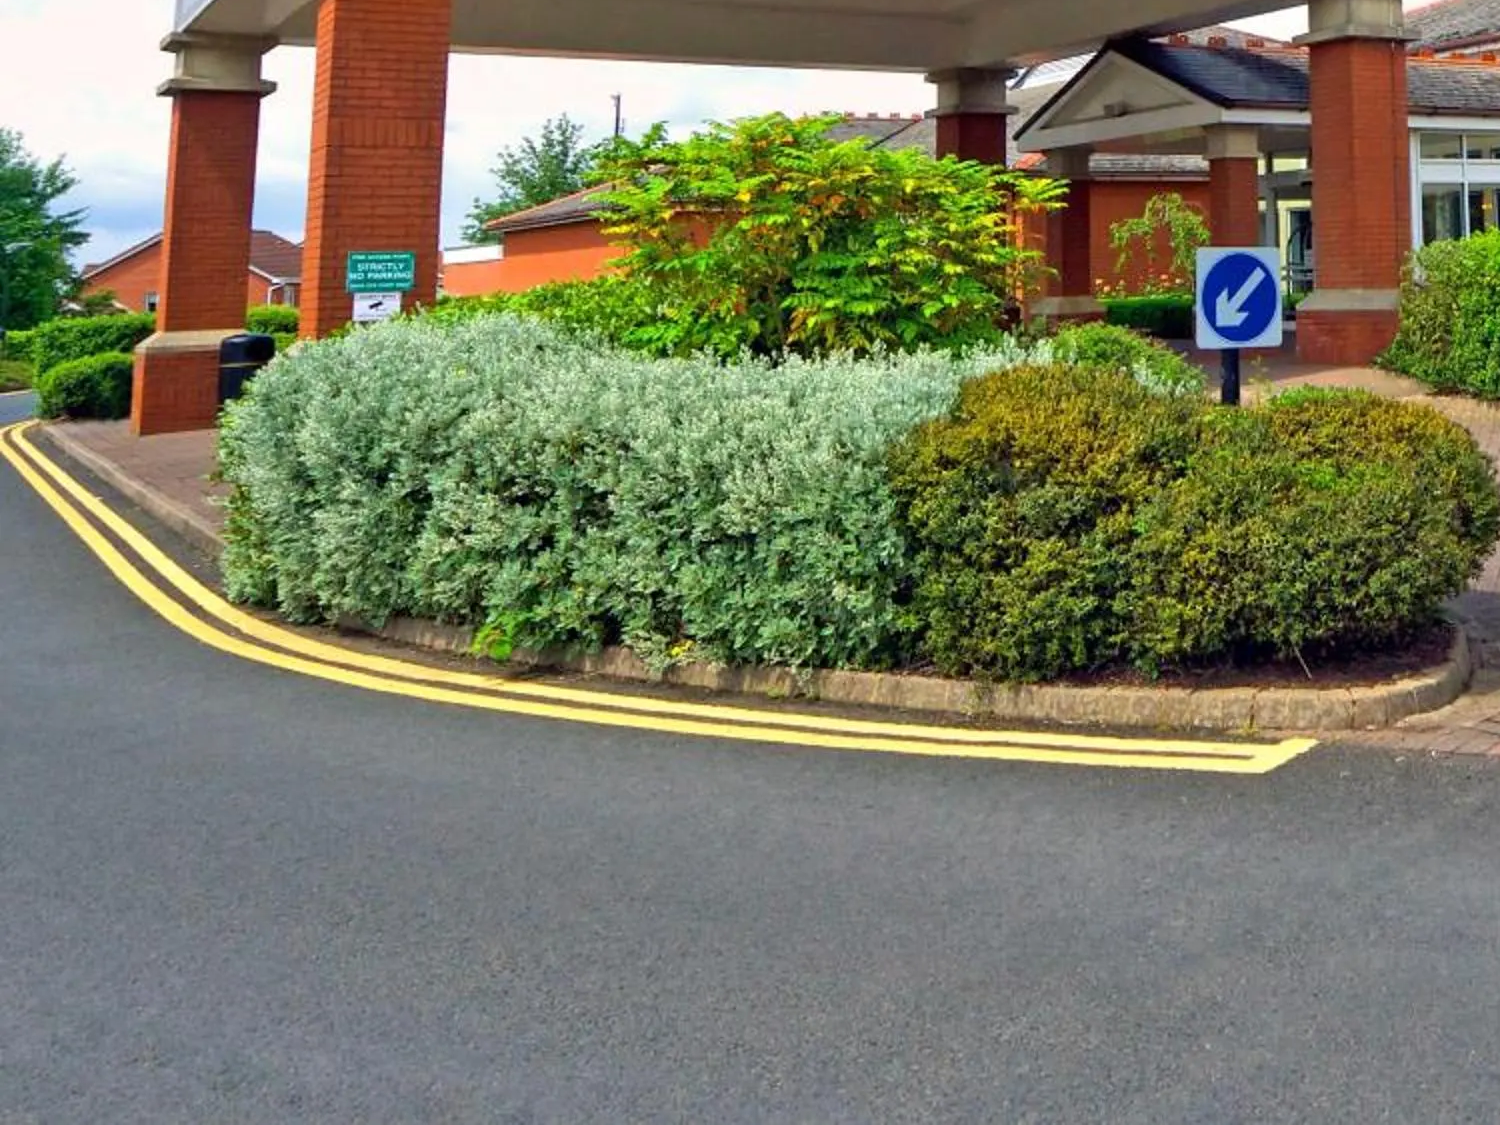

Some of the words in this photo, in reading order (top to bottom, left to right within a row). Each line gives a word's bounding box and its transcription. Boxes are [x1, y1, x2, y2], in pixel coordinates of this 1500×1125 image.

[357, 262, 405, 271] STRICTLY
[350, 272, 365, 280] NO
[367, 272, 410, 280] PARKING
